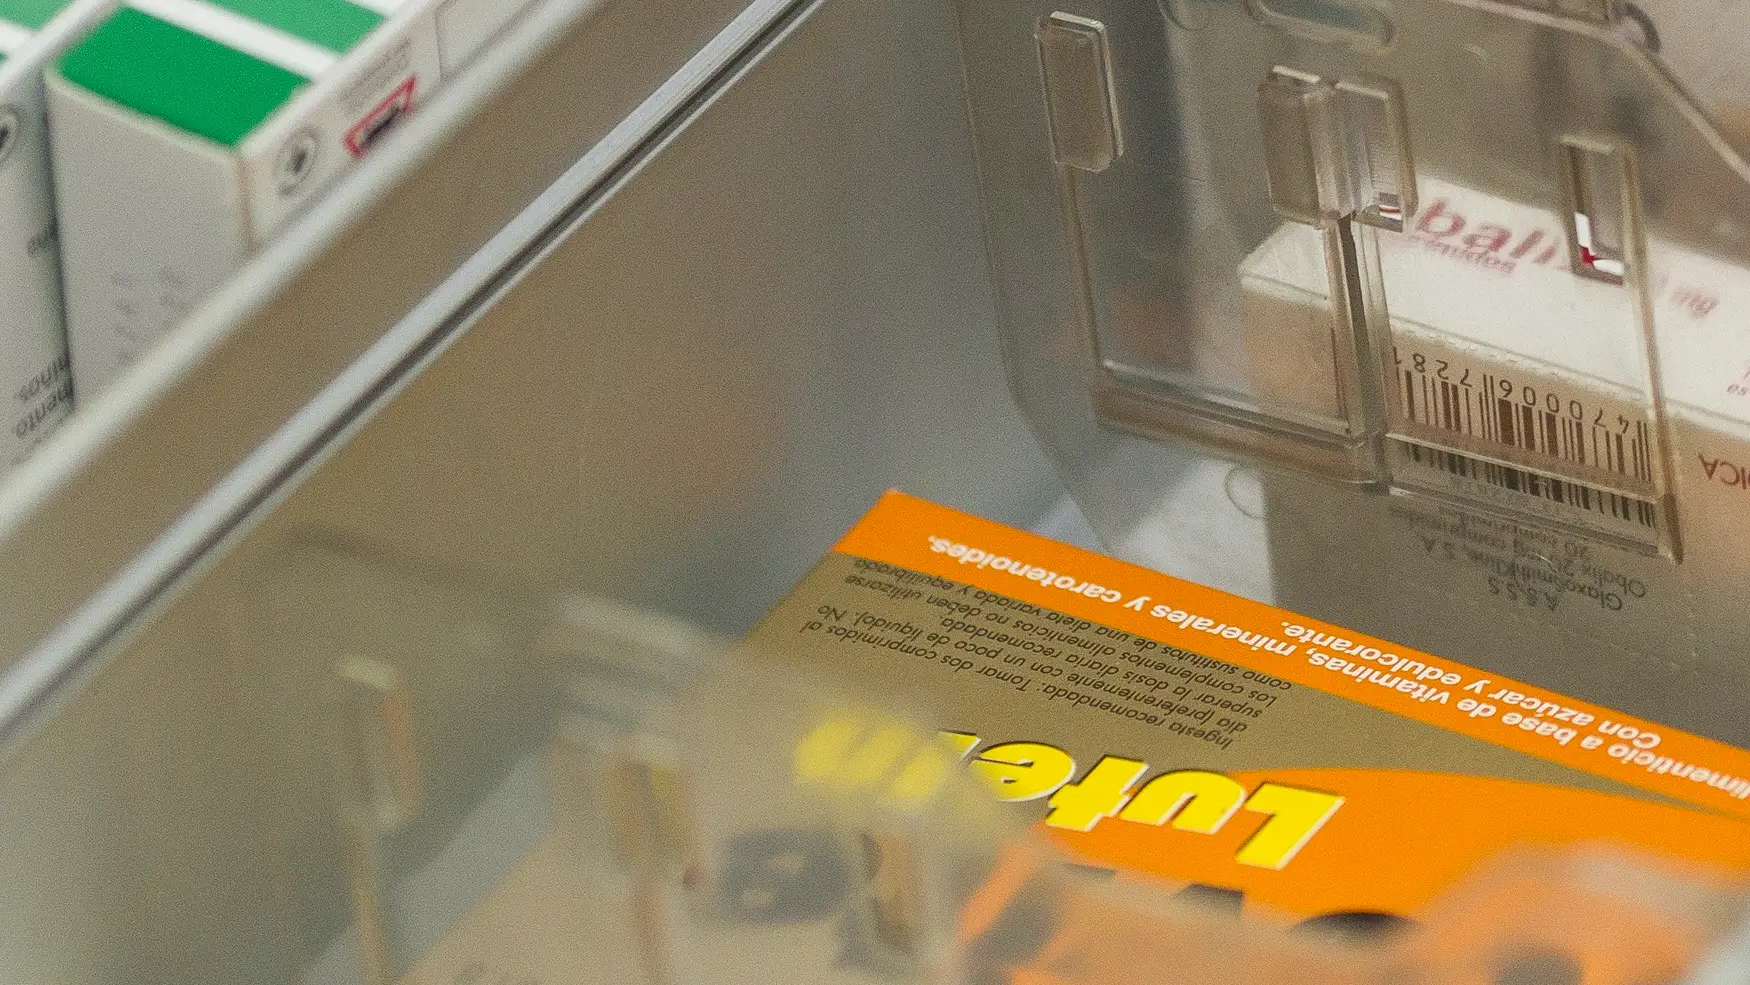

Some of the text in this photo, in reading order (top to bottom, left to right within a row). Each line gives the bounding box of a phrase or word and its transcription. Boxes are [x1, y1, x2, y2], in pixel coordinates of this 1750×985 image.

[1499, 380, 1630, 436] 470006
[926, 535, 1122, 607] carotenoides.
[959, 584, 972, 595] y
[1123, 592, 1150, 612] y
[815, 603, 846, 621] No
[973, 589, 1041, 619] variada
[802, 618, 823, 632] al
[1044, 611, 1091, 633] dieta
[1095, 625, 1128, 641] una
[1149, 604, 1297, 659] minerales
[826, 618, 938, 664] comprimidos
[844, 570, 1277, 707] Los complementos alimenticios no deben utilizarse
[924, 632, 950, 651] de
[952, 636, 1002, 662] poco
[1131, 637, 1157, 654] de
[933, 615, 1263, 718] superar la dosis diaria recomendada.
[940, 654, 974, 673] dos
[1002, 653, 1026, 667] un
[1029, 661, 1063, 677] con
[1159, 645, 1239, 675] sustitutos
[975, 664, 1032, 691] Tomar
[1241, 670, 1292, 691] como
[1281, 622, 1662, 750] Con azúcar y edulcorante.
[1305, 647, 1452, 705] vitaminas,
[1064, 673, 1214, 725] (preferentemente
[1454, 696, 1497, 721] de
[1167, 719, 1233, 749] Ingesta
[1214, 717, 1247, 736] día
[1497, 709, 1577, 746] base
[1577, 733, 1603, 750] a
